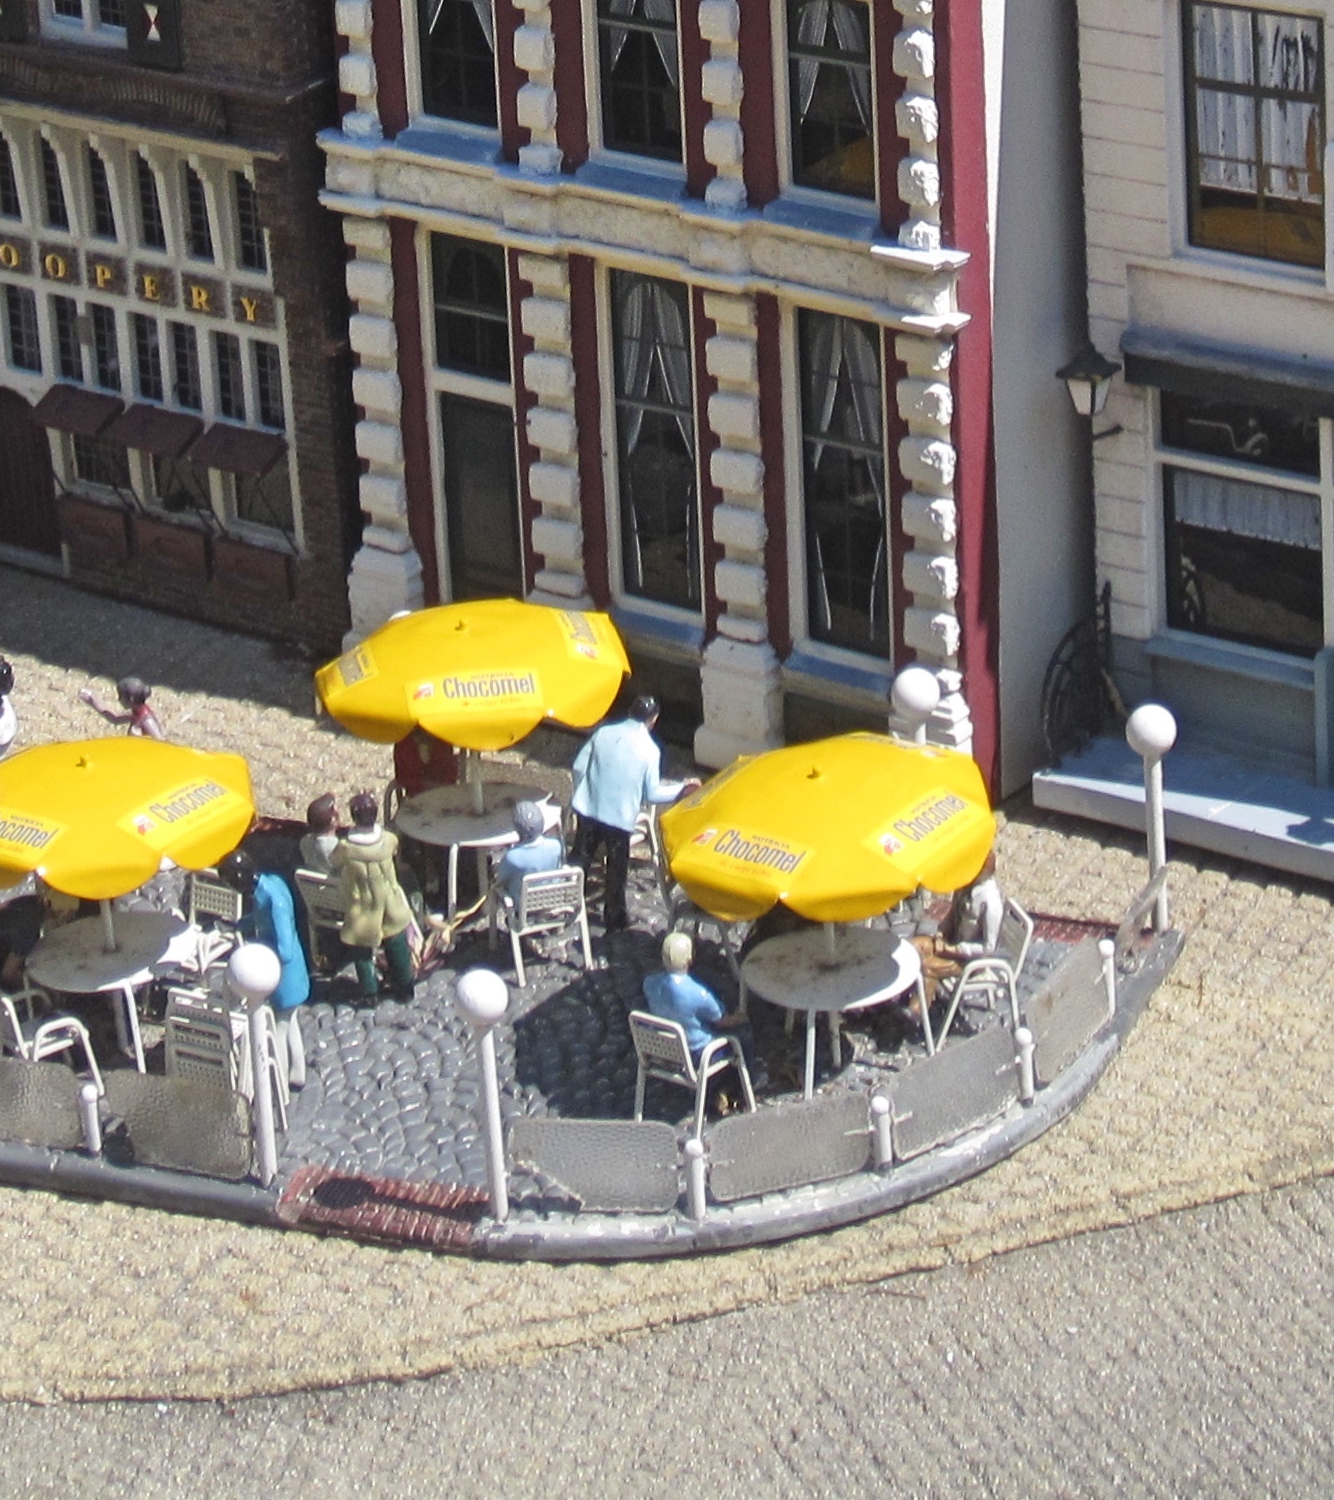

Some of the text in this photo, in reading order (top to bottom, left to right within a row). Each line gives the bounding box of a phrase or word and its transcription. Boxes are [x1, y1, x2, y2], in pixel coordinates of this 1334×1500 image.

[442, 672, 535, 699] Chocomel
[148, 778, 229, 823] Chocomel
[892, 789, 969, 842] Chocomel
[713, 828, 807, 875] Chocomel
